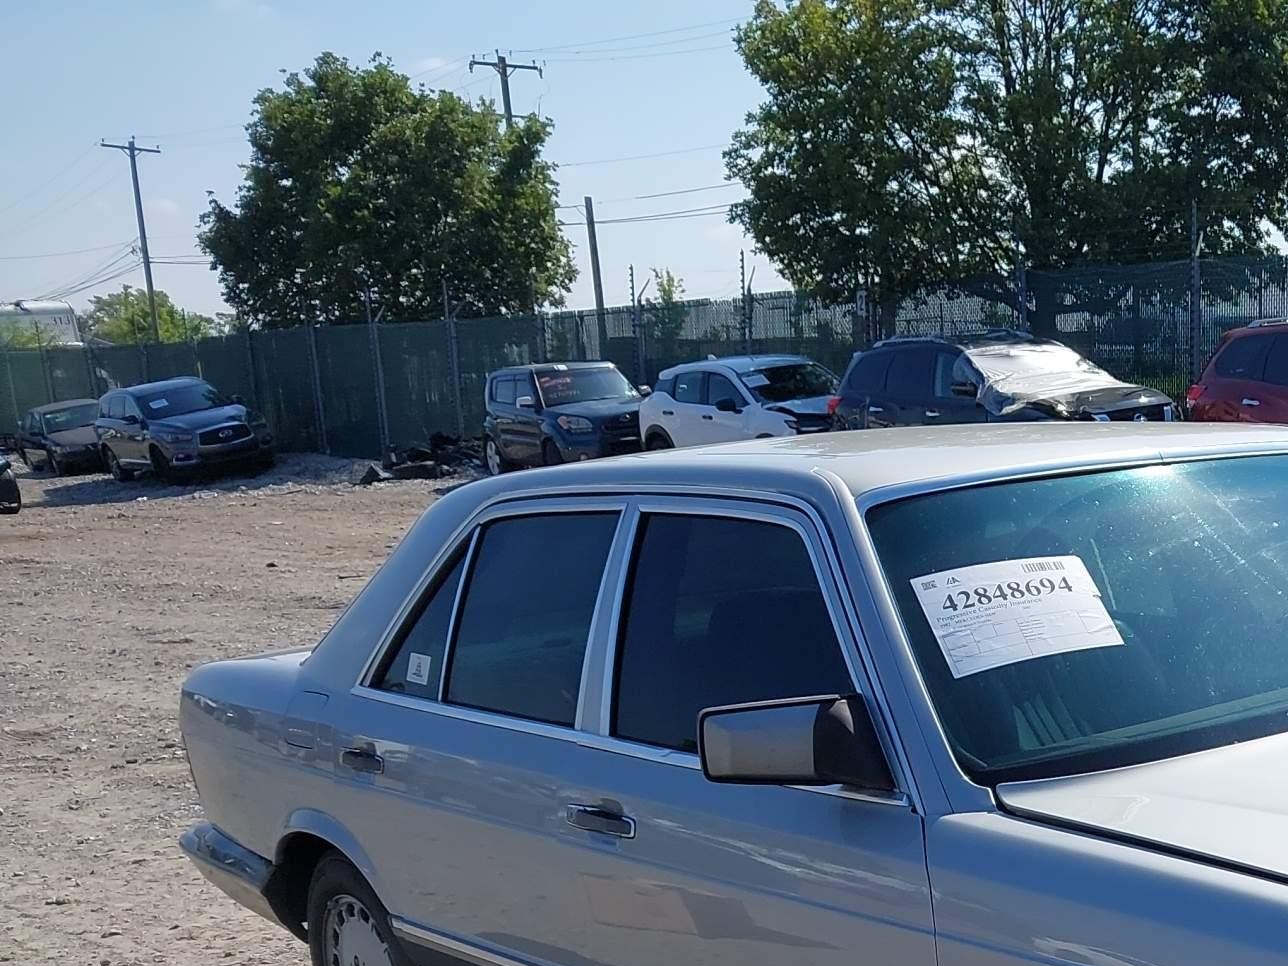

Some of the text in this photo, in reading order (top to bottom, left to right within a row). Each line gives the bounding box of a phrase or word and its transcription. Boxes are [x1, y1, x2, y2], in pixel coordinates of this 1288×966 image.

[942, 576, 1073, 611] 42848694
[936, 608, 977, 622] Progressive
[1010, 598, 1042, 608] Insurance
